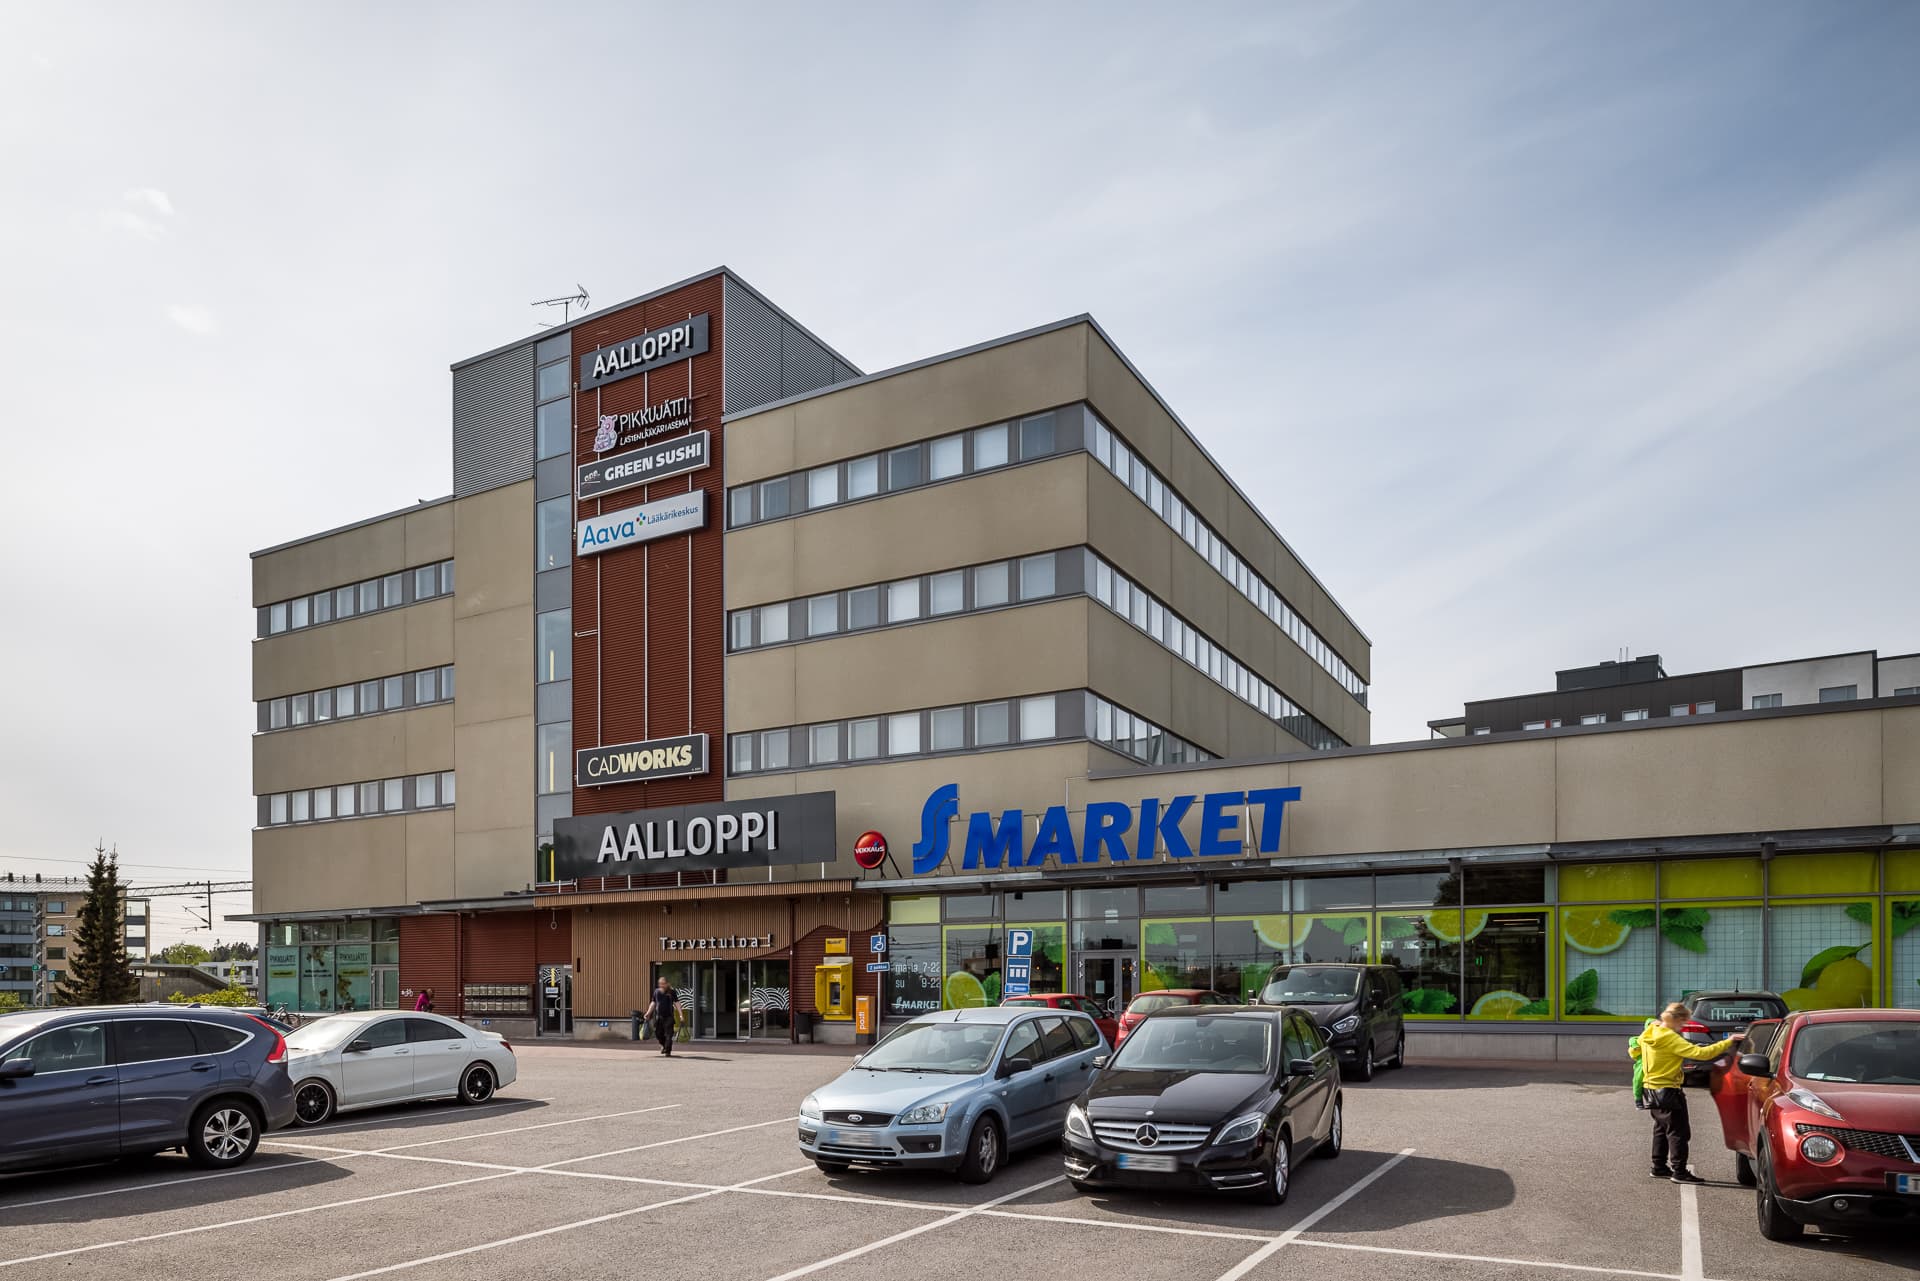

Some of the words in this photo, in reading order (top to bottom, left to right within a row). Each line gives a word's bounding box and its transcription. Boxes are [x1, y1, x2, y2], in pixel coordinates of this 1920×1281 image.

[592, 324, 691, 378] AALLOPPI
[620, 397, 687, 432] PIKKUJÄTTI
[604, 456, 653, 481] GREEN
[655, 442, 701, 467] SUSHI
[581, 519, 636, 549] Aava
[647, 505, 699, 525] Lääkärikeskus
[587, 744, 693, 777] CADWORKS
[597, 810, 777, 863] AALLOPPI
[962, 786, 1302, 869] MARKET
[1012, 931, 1029, 955] P
[895, 979, 905, 988] su
[902, 1000, 941, 1009] MARKET
